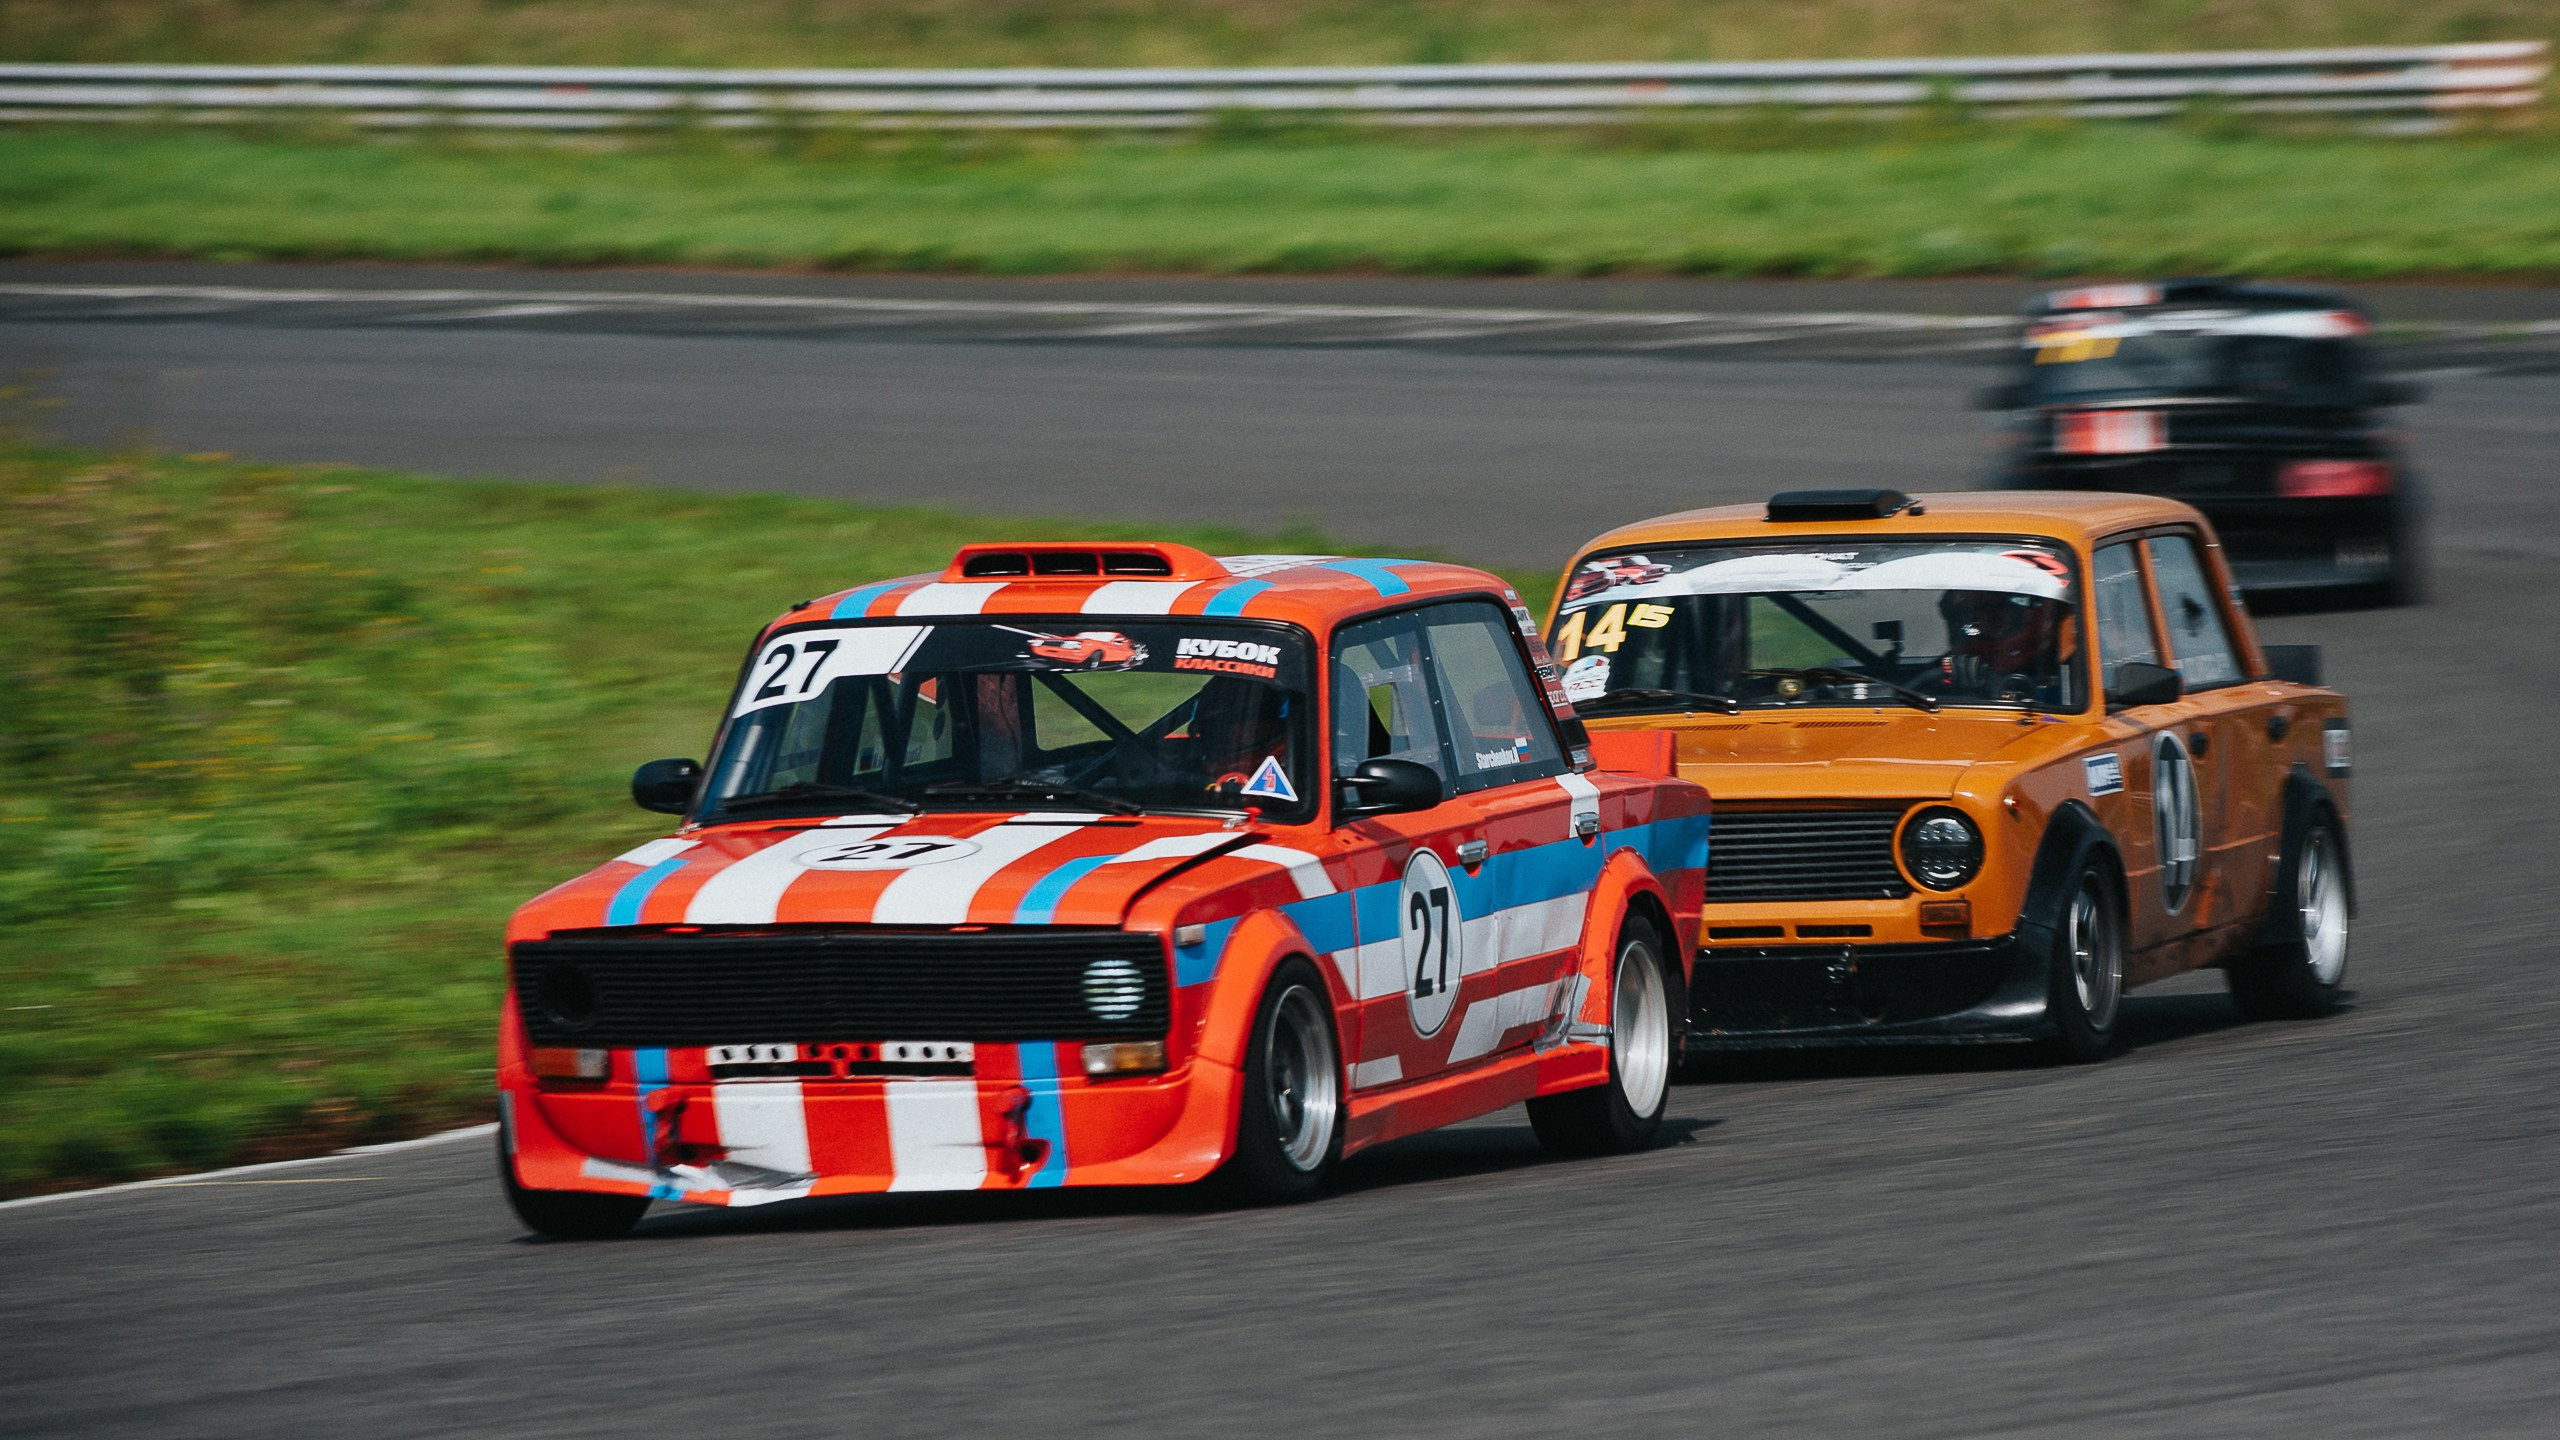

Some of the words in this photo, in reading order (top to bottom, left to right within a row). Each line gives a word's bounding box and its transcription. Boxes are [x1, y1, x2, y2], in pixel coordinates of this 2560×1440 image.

[1176, 638, 1281, 665] КУБОК
[1557, 603, 1627, 662] 14
[753, 639, 840, 703] 27
[1173, 658, 1277, 679] КЛАССИКИ
[817, 842, 958, 862] 27
[1410, 886, 1449, 999] 27
